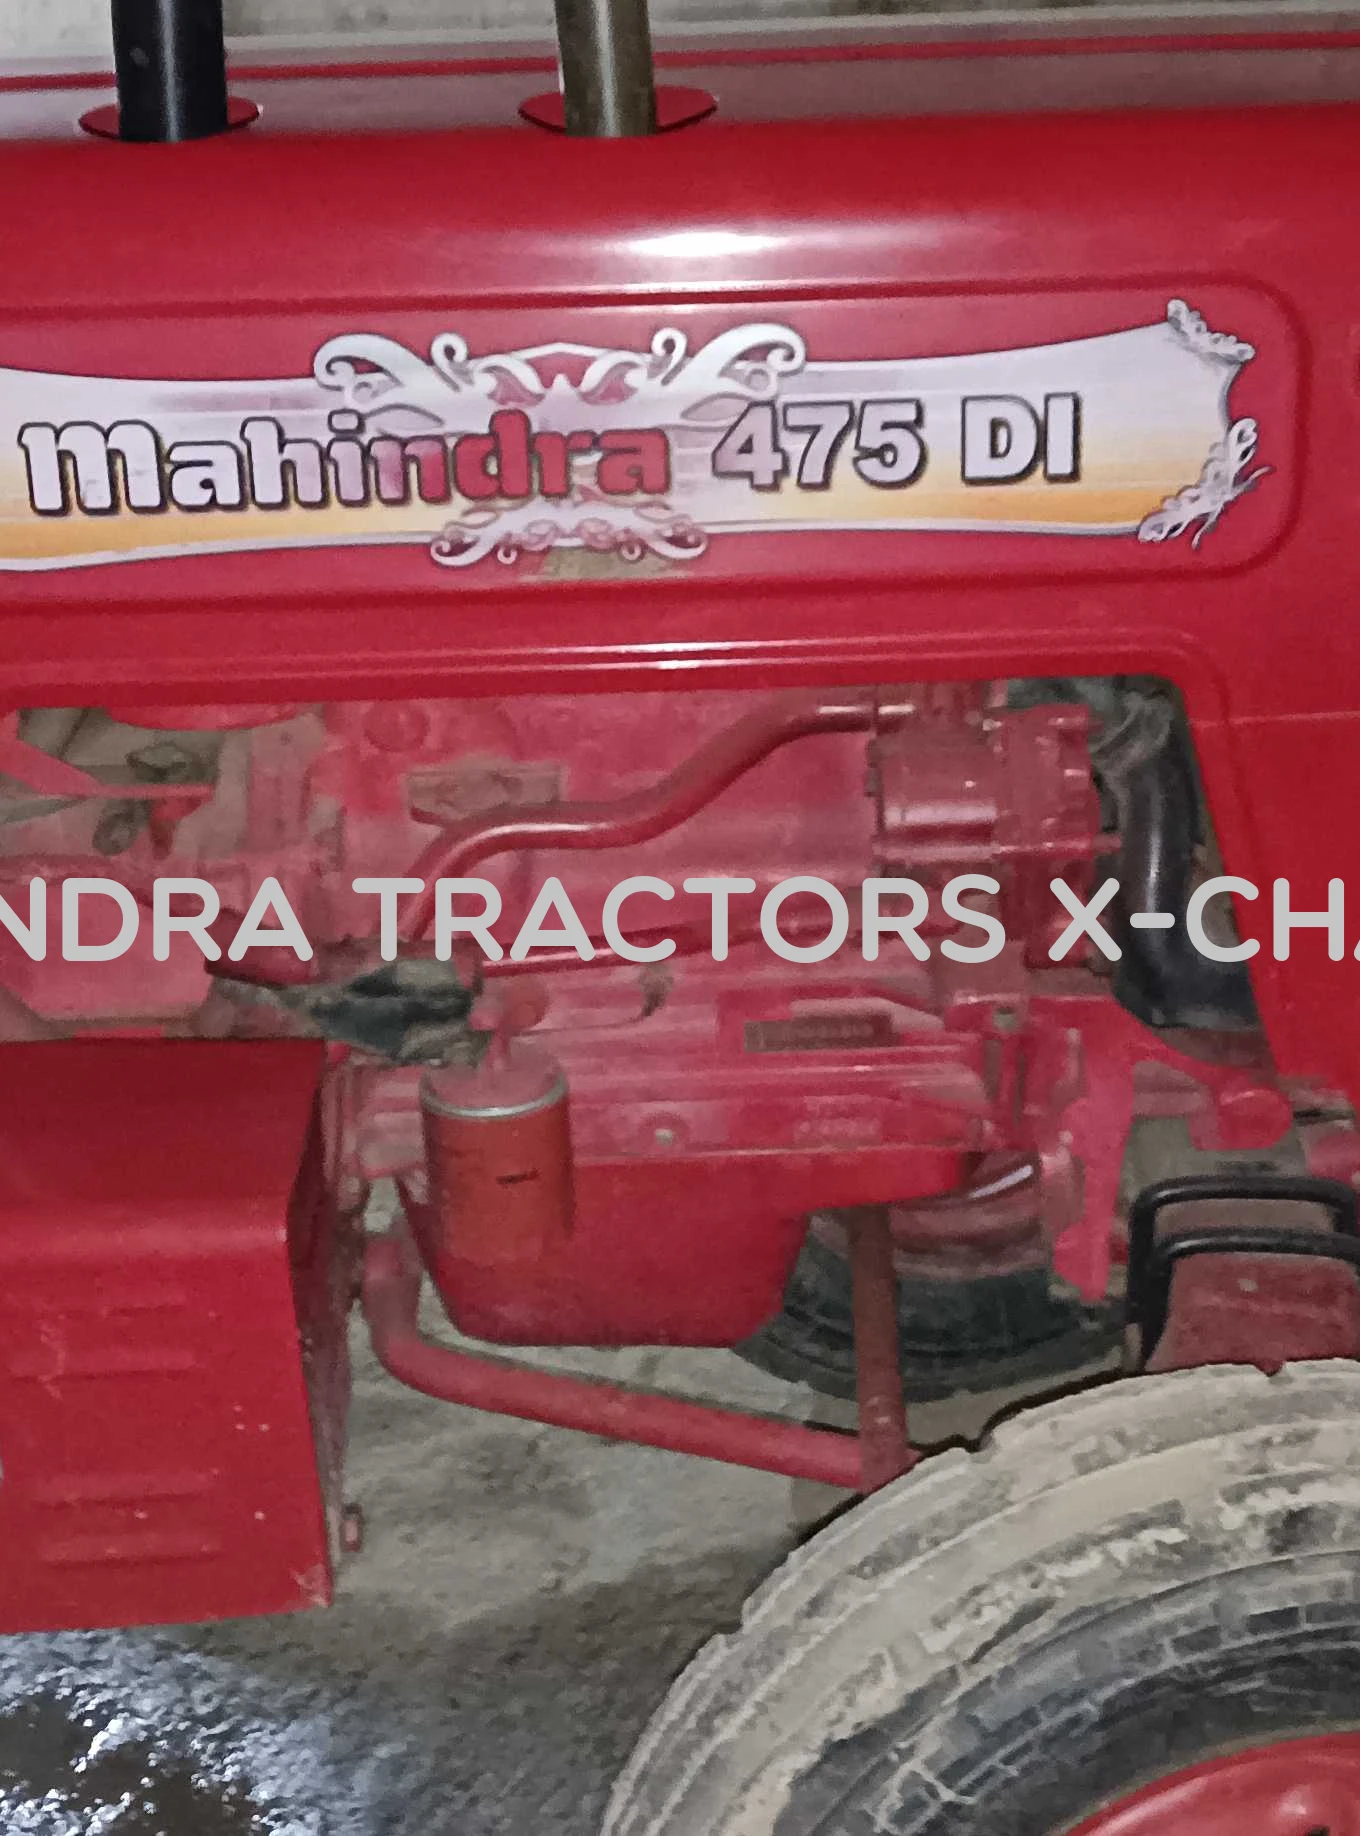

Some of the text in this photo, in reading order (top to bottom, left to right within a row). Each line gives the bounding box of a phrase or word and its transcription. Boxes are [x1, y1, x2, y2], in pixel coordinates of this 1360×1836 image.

[17, 392, 1081, 516] Mahindra 475 DI
